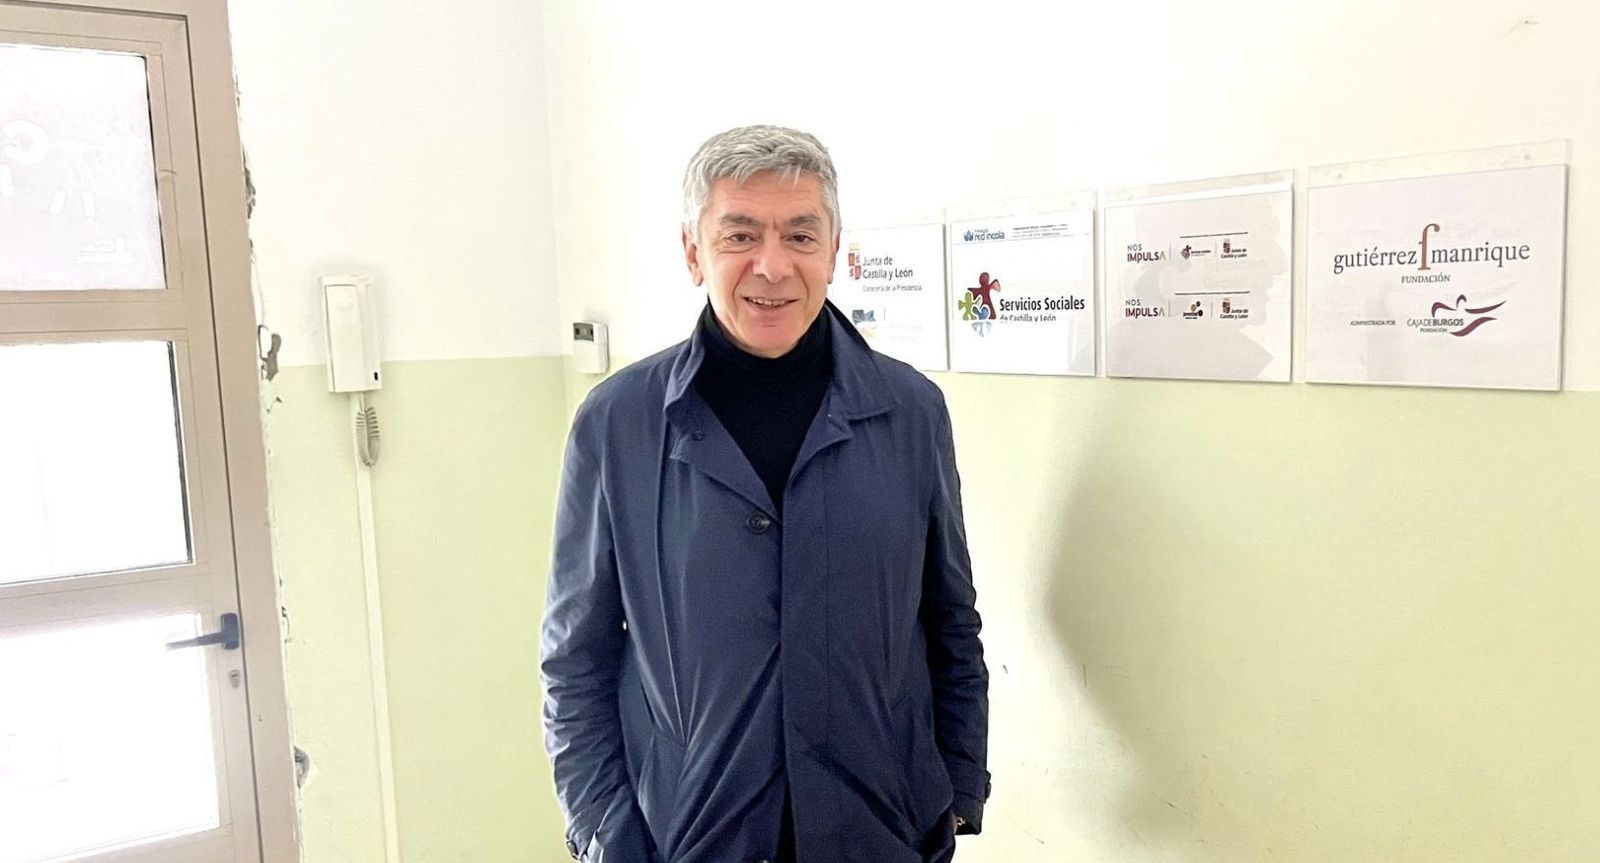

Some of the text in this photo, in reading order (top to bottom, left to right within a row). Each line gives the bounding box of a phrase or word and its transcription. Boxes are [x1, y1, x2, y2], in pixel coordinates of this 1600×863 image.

[1127, 243, 1142, 251] NOS
[862, 255, 893, 267] Junta de
[1333, 247, 1416, 274] gutiérrez
[1430, 242, 1530, 268] manrique
[862, 268, 913, 281] Castilla y León
[1401, 273, 1450, 284] FUNDACIÓN
[999, 295, 1085, 311] Servicios Sociales
[1125, 298, 1141, 306] NOS
